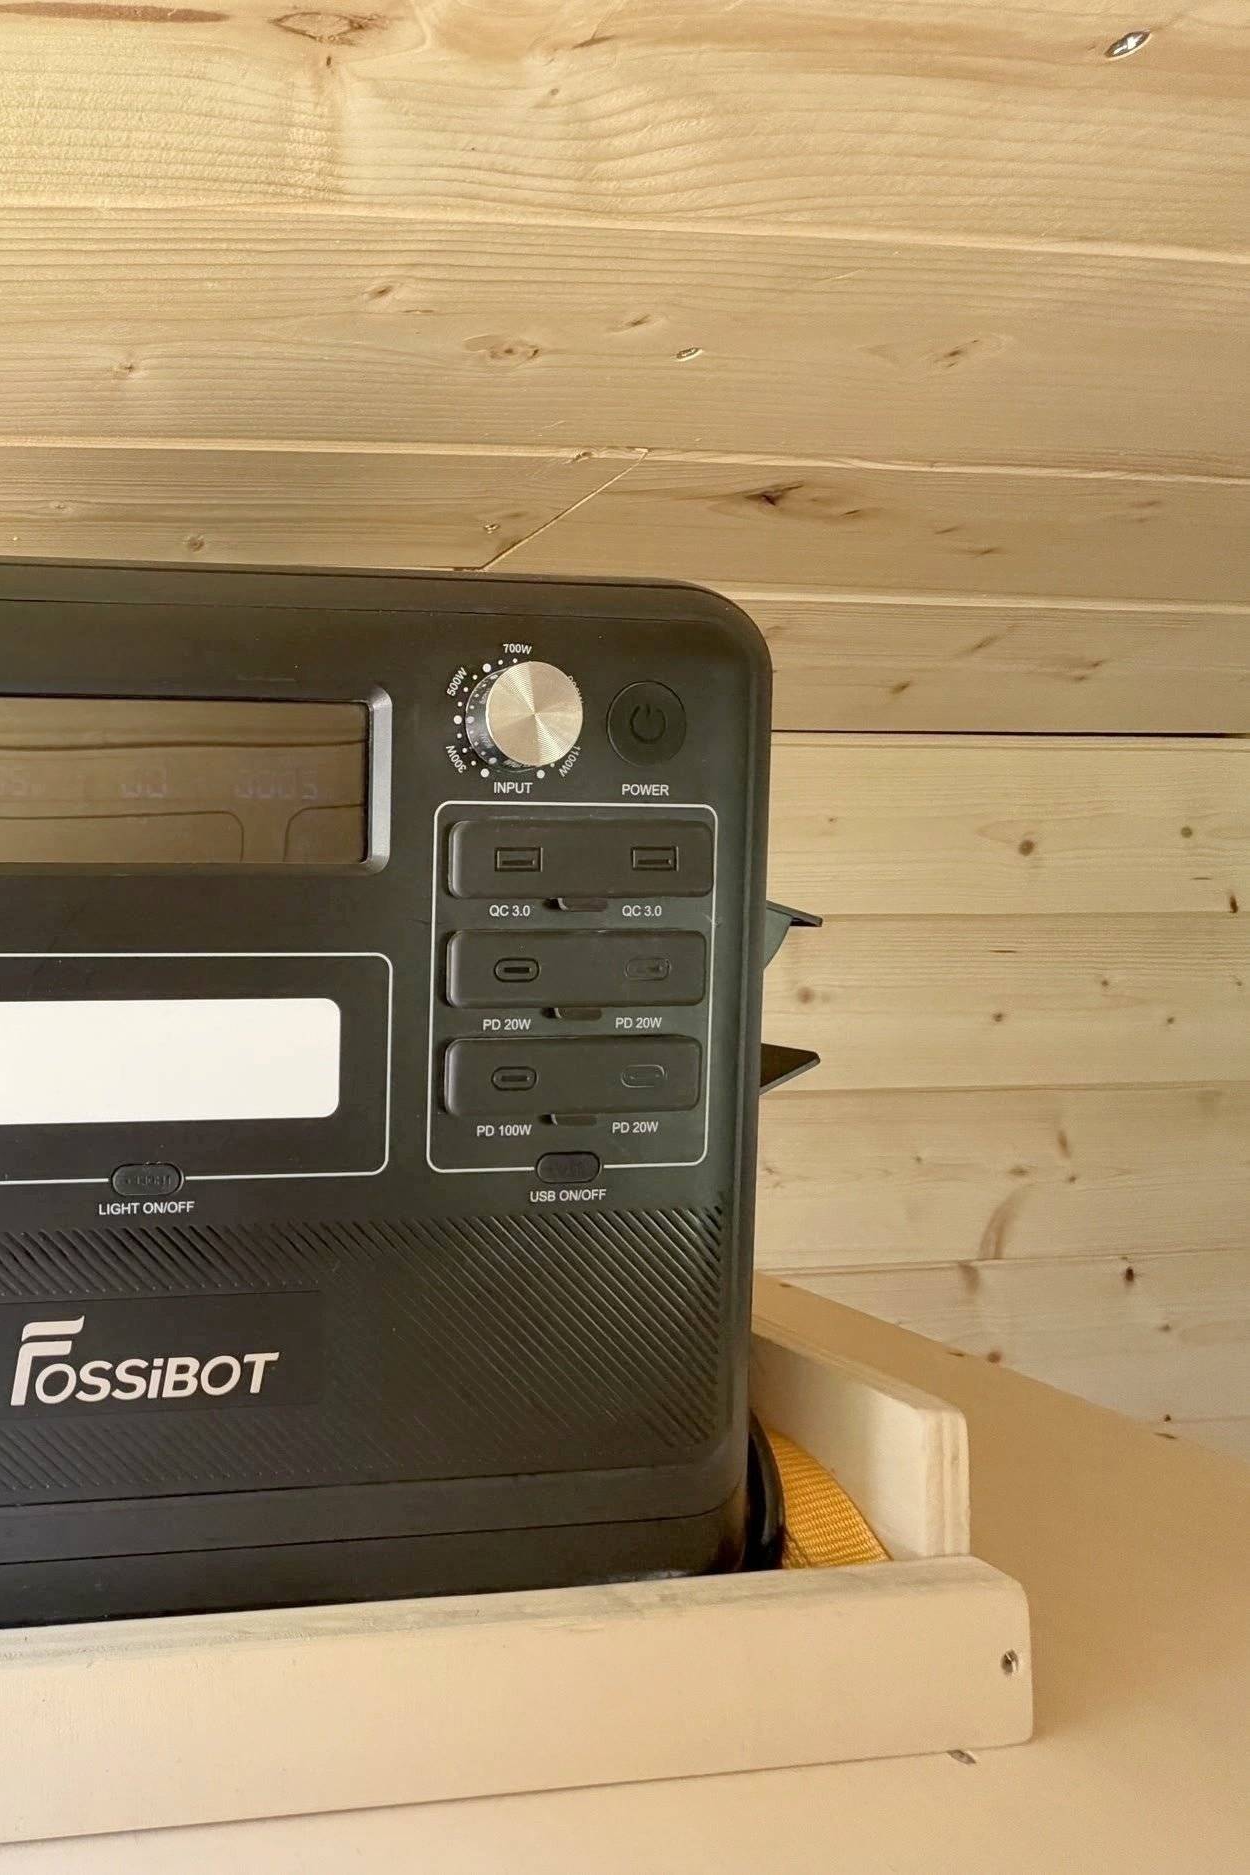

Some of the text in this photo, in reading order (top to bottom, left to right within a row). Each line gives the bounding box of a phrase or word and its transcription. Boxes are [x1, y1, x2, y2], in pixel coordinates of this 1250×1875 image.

[502, 643, 533, 655] 700W
[445, 667, 468, 697] 500W
[445, 745, 467, 774] 300W
[493, 781, 534, 794] INPUT
[621, 783, 670, 797] POWER
[489, 904, 531, 917] QC 3.0
[621, 904, 663, 918] QC 3.0
[482, 1018, 532, 1031] PD 20W
[615, 1016, 663, 1029] PD 20W
[476, 1124, 533, 1137] PD 100W
[612, 1121, 659, 1134] PD 20W
[529, 1188, 607, 1203] USB ON/OFF
[98, 1200, 195, 1216] LIGHT ON/OFF
